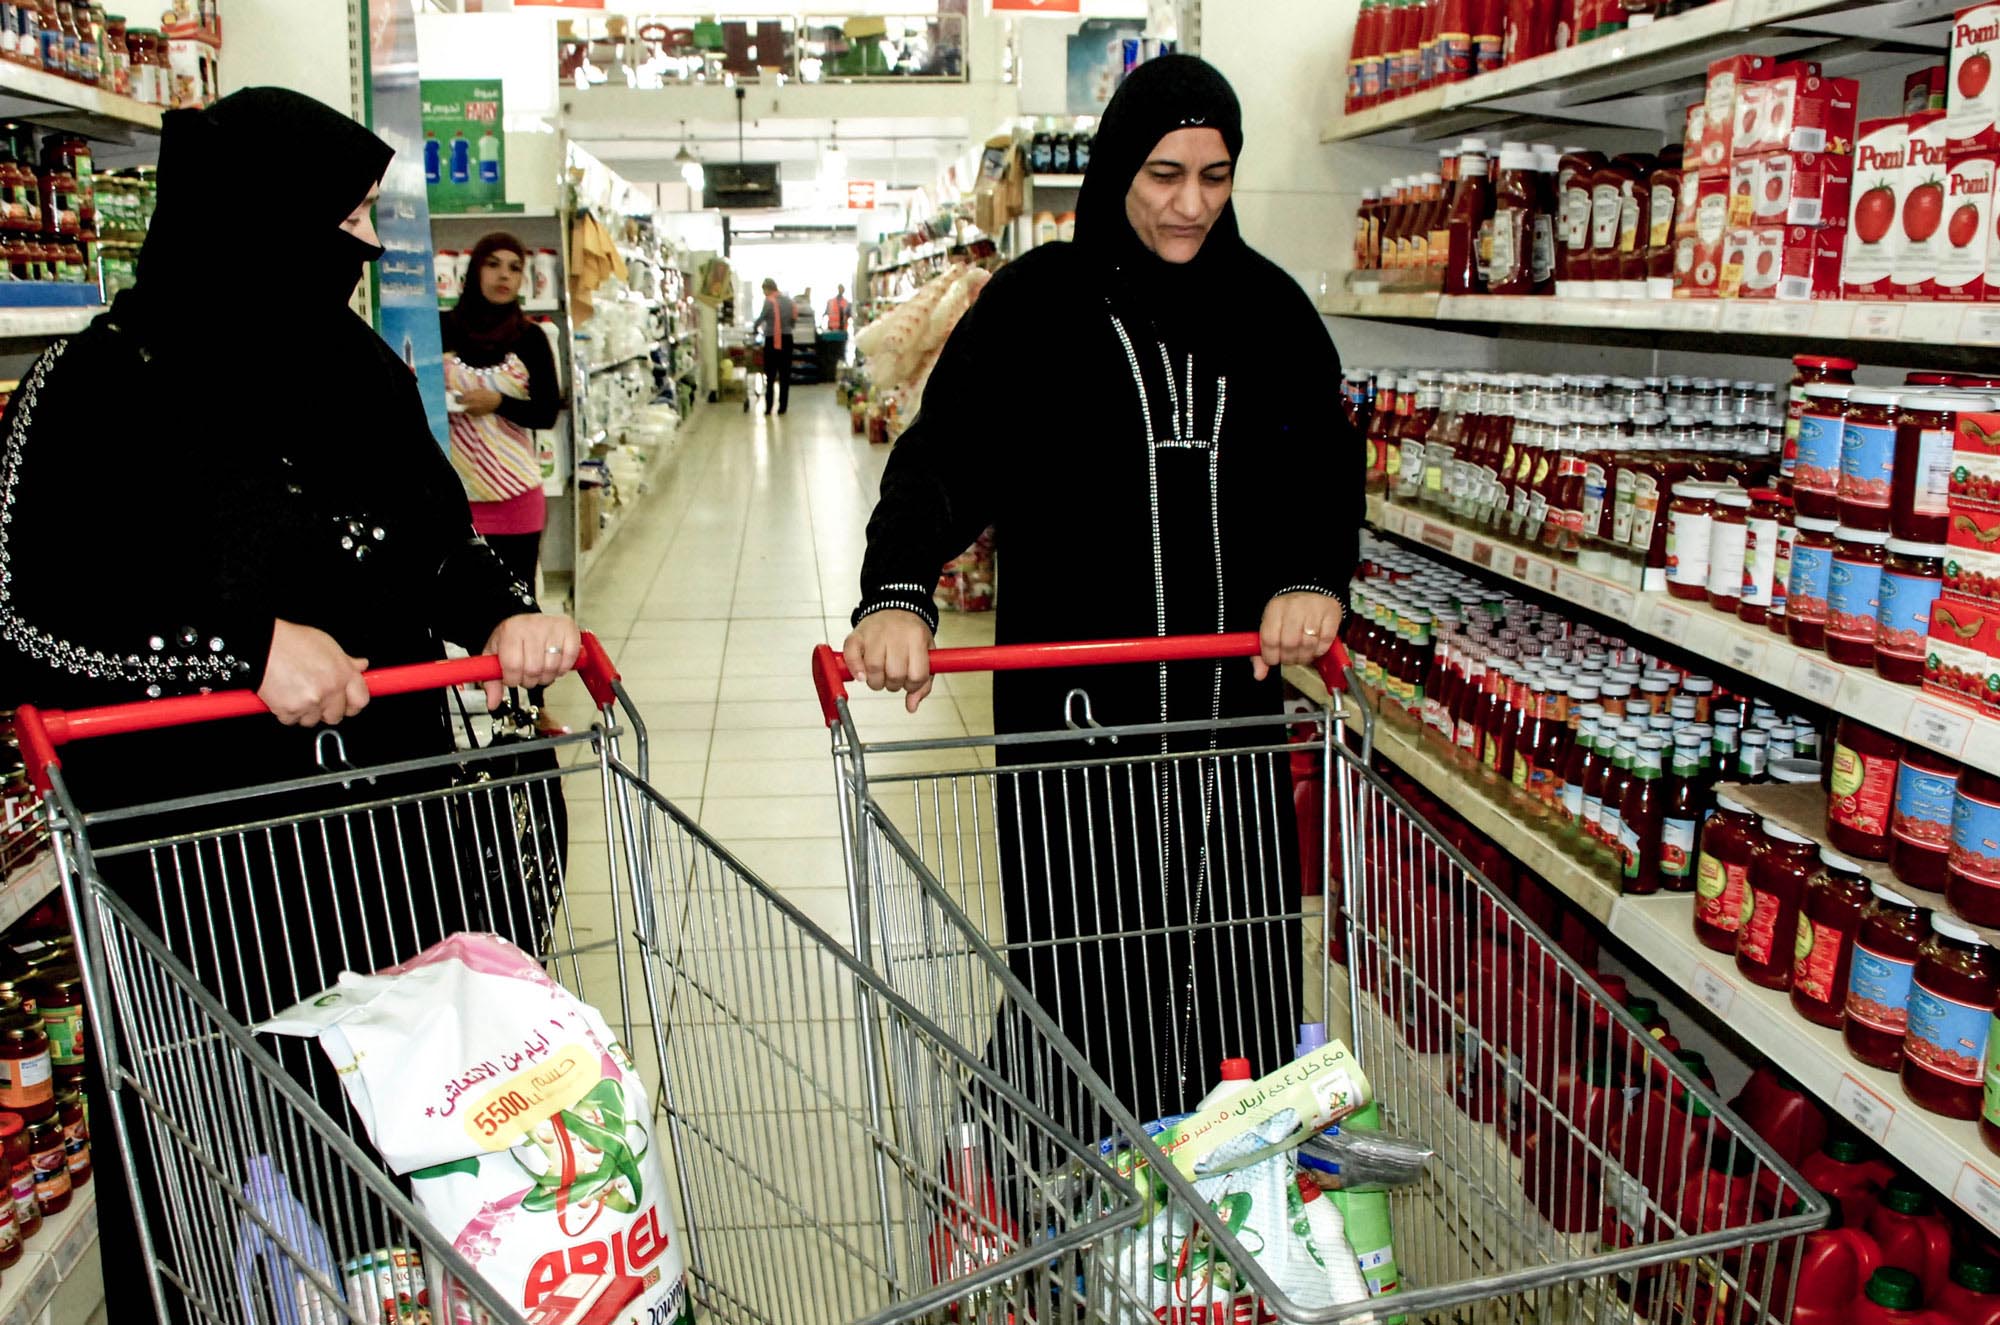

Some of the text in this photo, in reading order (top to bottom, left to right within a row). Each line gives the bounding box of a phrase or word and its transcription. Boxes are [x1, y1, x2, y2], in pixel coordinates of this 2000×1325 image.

[1857, 144, 1905, 171] Pomi
[1907, 139, 1946, 166] Pom
[1950, 172, 1989, 196] Pomi
[524, 1029, 550, 1064] أيام
[1323, 1049, 1344, 1067] مع
[502, 1052, 524, 1072] من
[1297, 1061, 1321, 1081] كل
[473, 1090, 530, 1137] 5500
[524, 1204, 669, 1309] ARIEL
